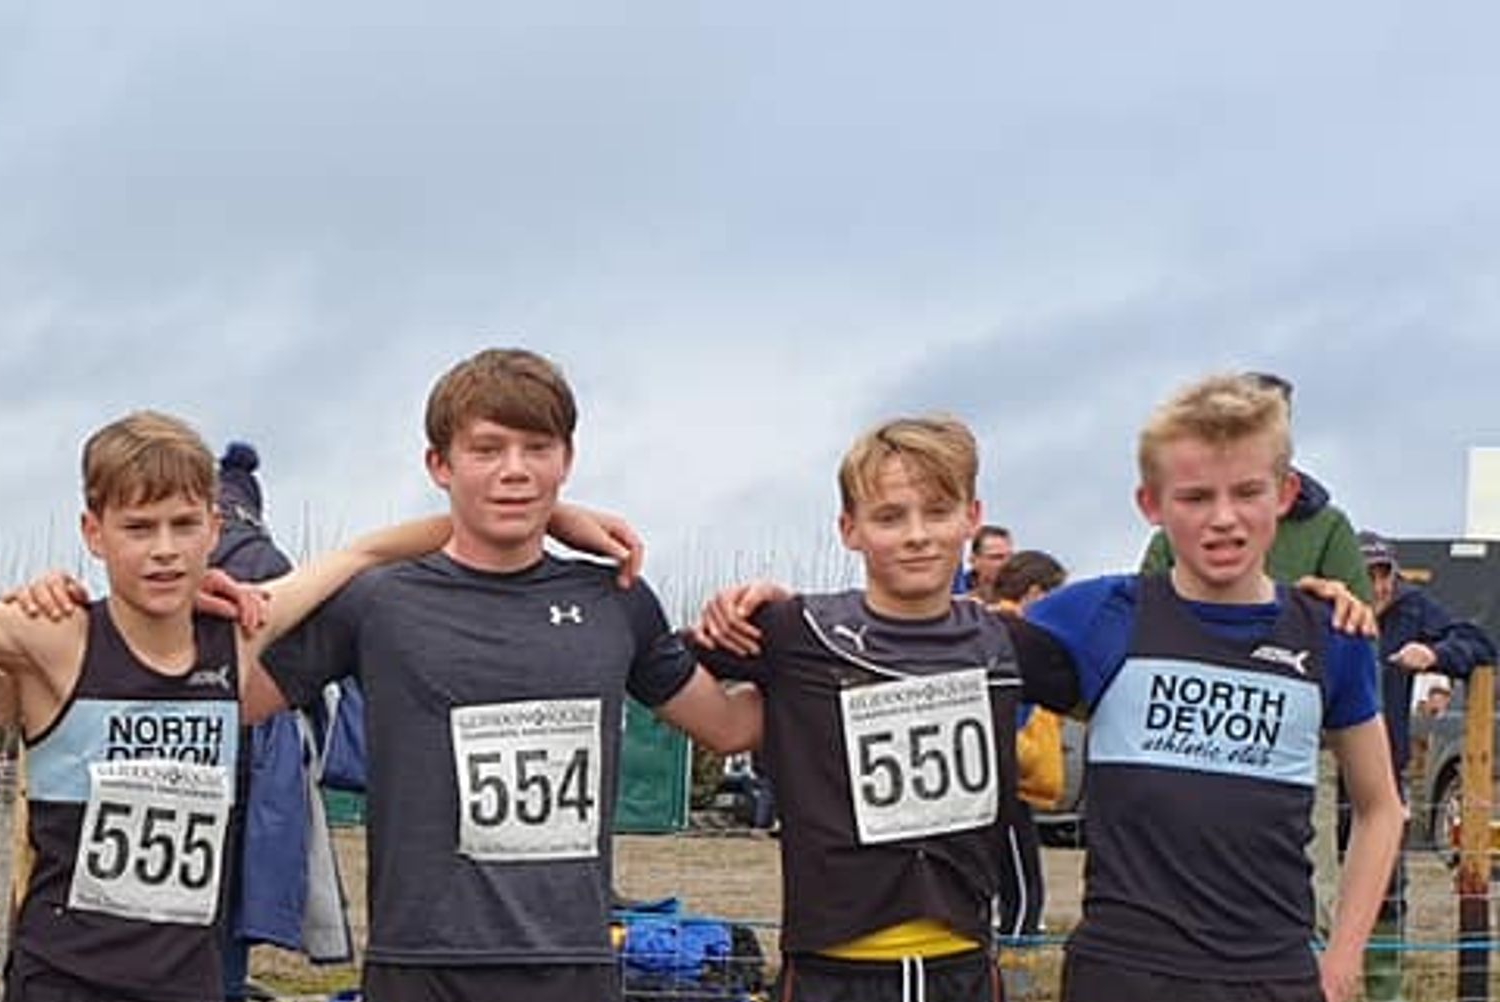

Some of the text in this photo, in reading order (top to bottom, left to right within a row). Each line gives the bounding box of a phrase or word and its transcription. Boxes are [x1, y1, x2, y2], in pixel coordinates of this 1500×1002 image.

[1147, 704, 1281, 745] DEVON
[1153, 675, 1286, 716] NORTH
[108, 716, 223, 745] NORTH
[467, 748, 594, 826] 554
[857, 718, 990, 808] 550
[86, 803, 217, 889] 555
